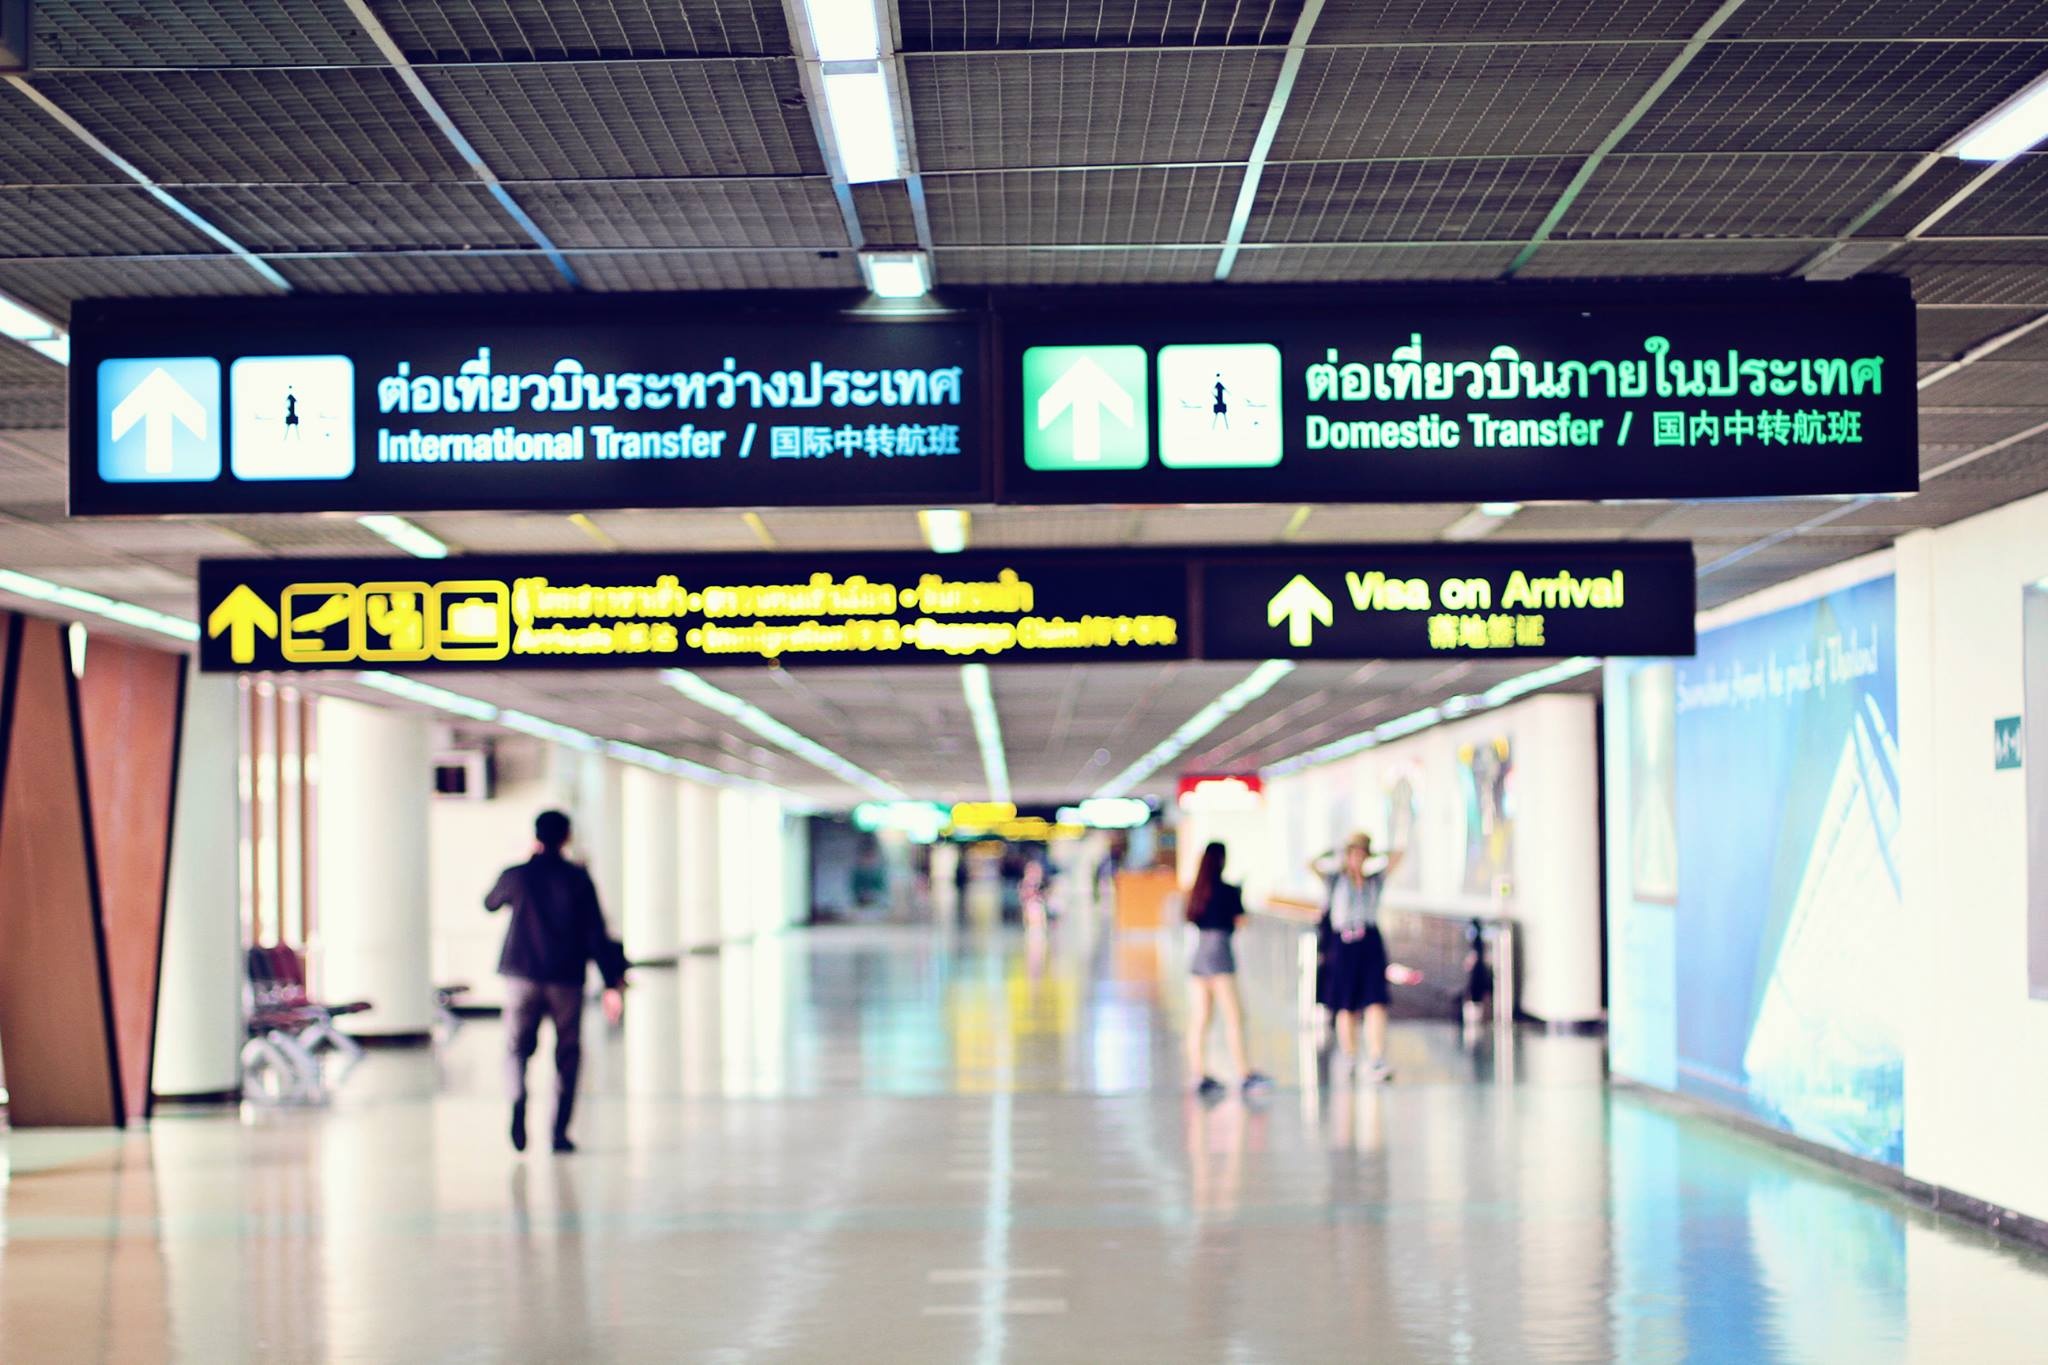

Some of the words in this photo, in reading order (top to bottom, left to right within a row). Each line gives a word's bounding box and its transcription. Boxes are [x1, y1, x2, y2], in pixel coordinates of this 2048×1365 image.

[378, 347, 962, 413] ต่อเที่ยวบินระหว่างประเทศ
[1306, 333, 1883, 401] ต่อเที่ยวบินภายในประเทศ
[379, 426, 584, 462] International
[590, 424, 726, 460] Transfer
[739, 423, 757, 458] /
[771, 424, 959, 459] 国际中转航班
[1306, 414, 1460, 449] Domestic
[1466, 412, 1603, 448] Transfer
[1617, 411, 1633, 446] /
[1653, 409, 1862, 446] 国内中转航班
[1346, 572, 1431, 610] Visa
[1438, 578, 1491, 610] on
[1501, 570, 1623, 609] Arrival
